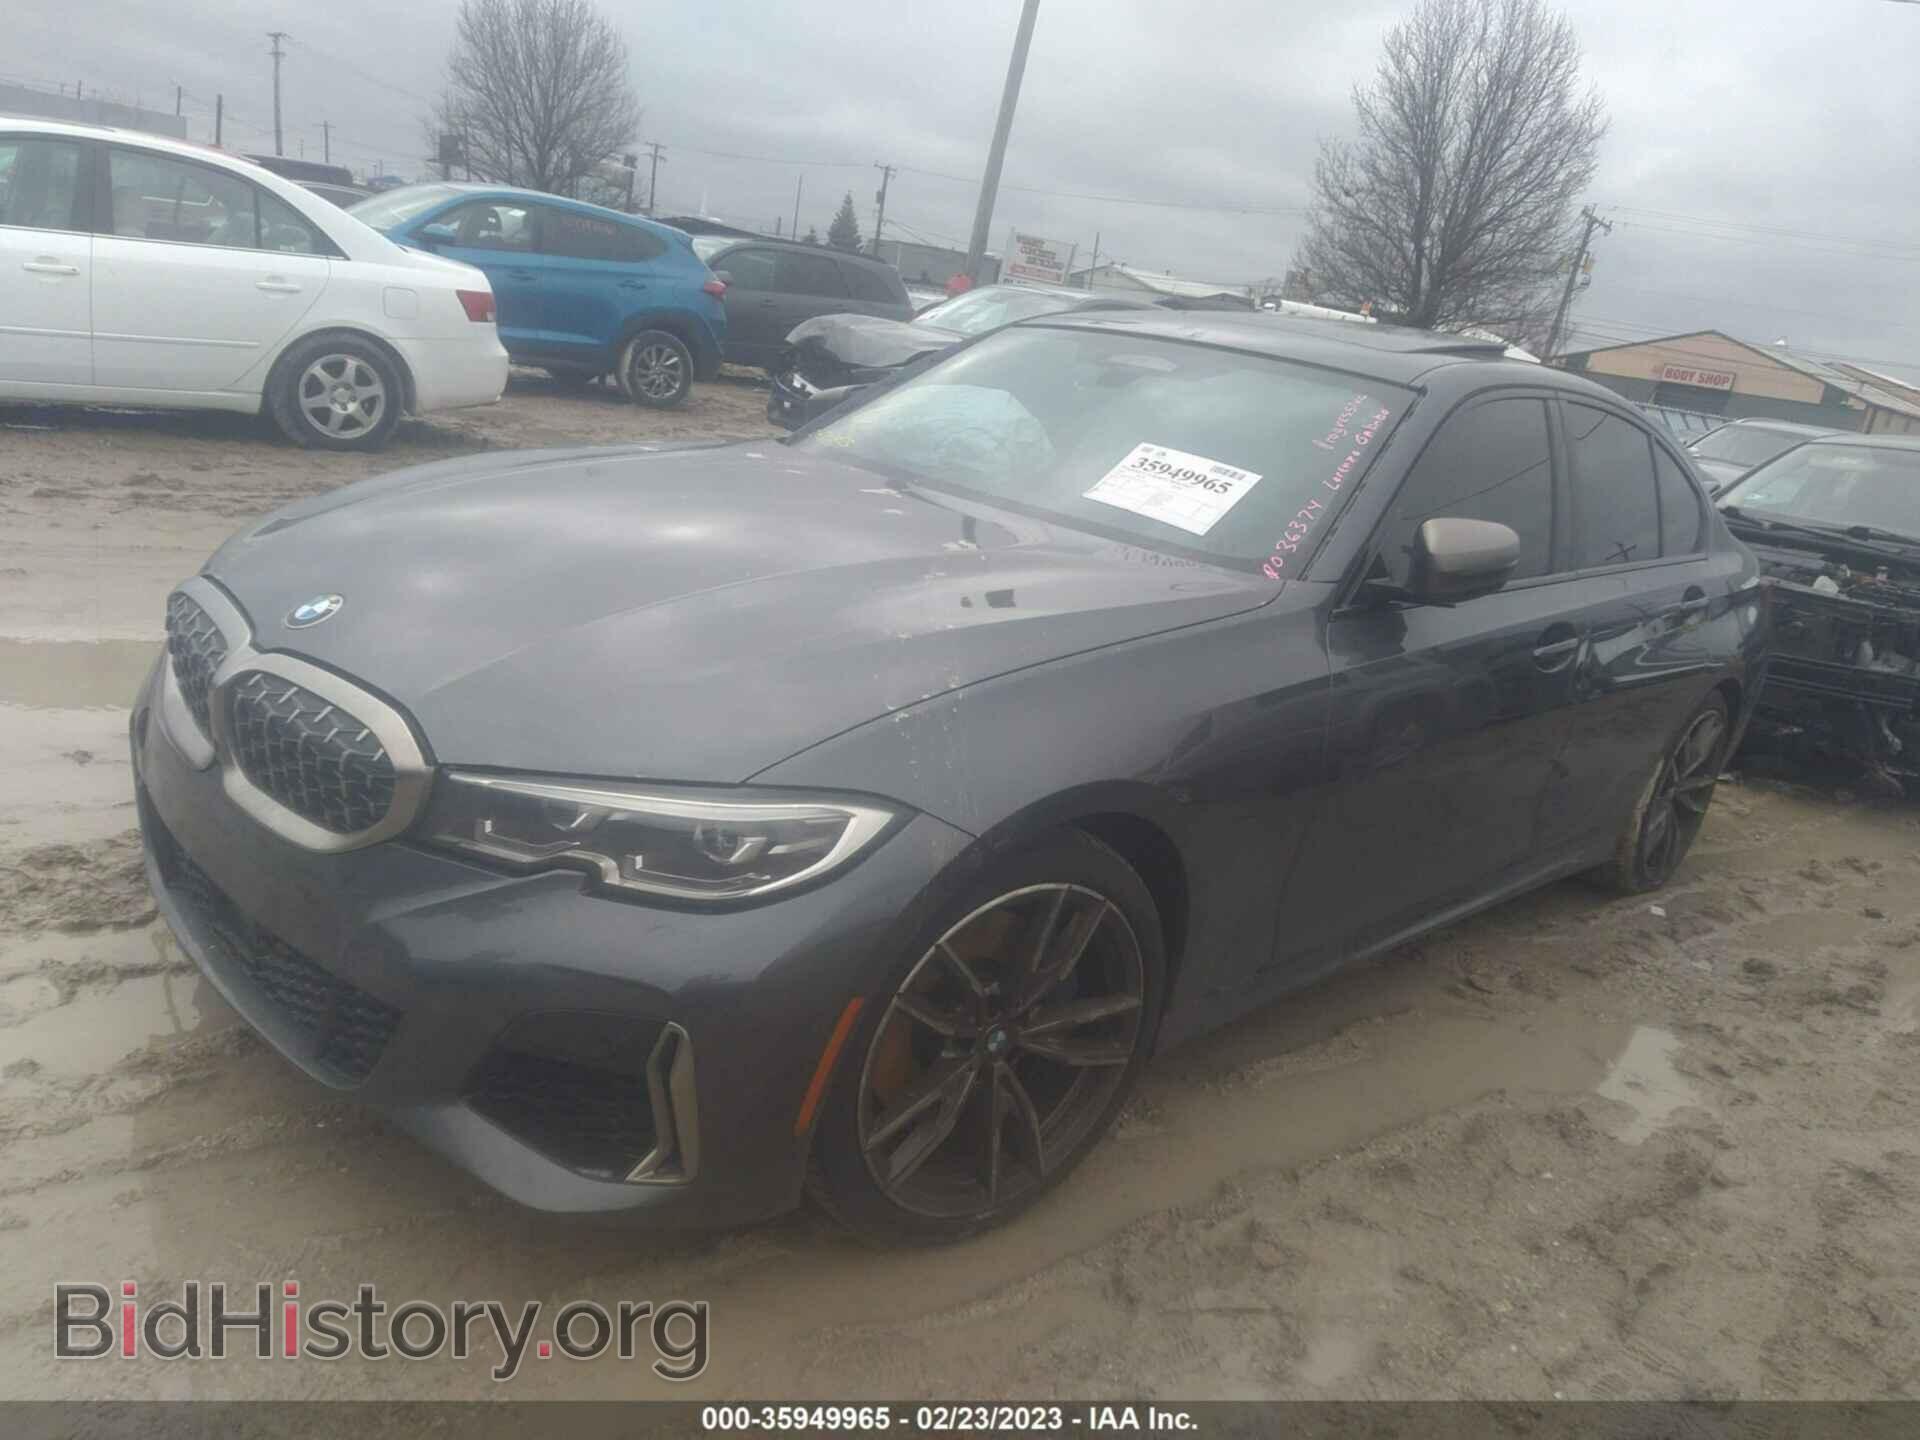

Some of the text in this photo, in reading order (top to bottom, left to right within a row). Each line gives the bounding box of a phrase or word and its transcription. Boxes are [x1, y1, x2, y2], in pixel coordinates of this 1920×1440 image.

[1663, 367, 1730, 385] BODY SHOP
[1131, 457, 1233, 494] 35949965
